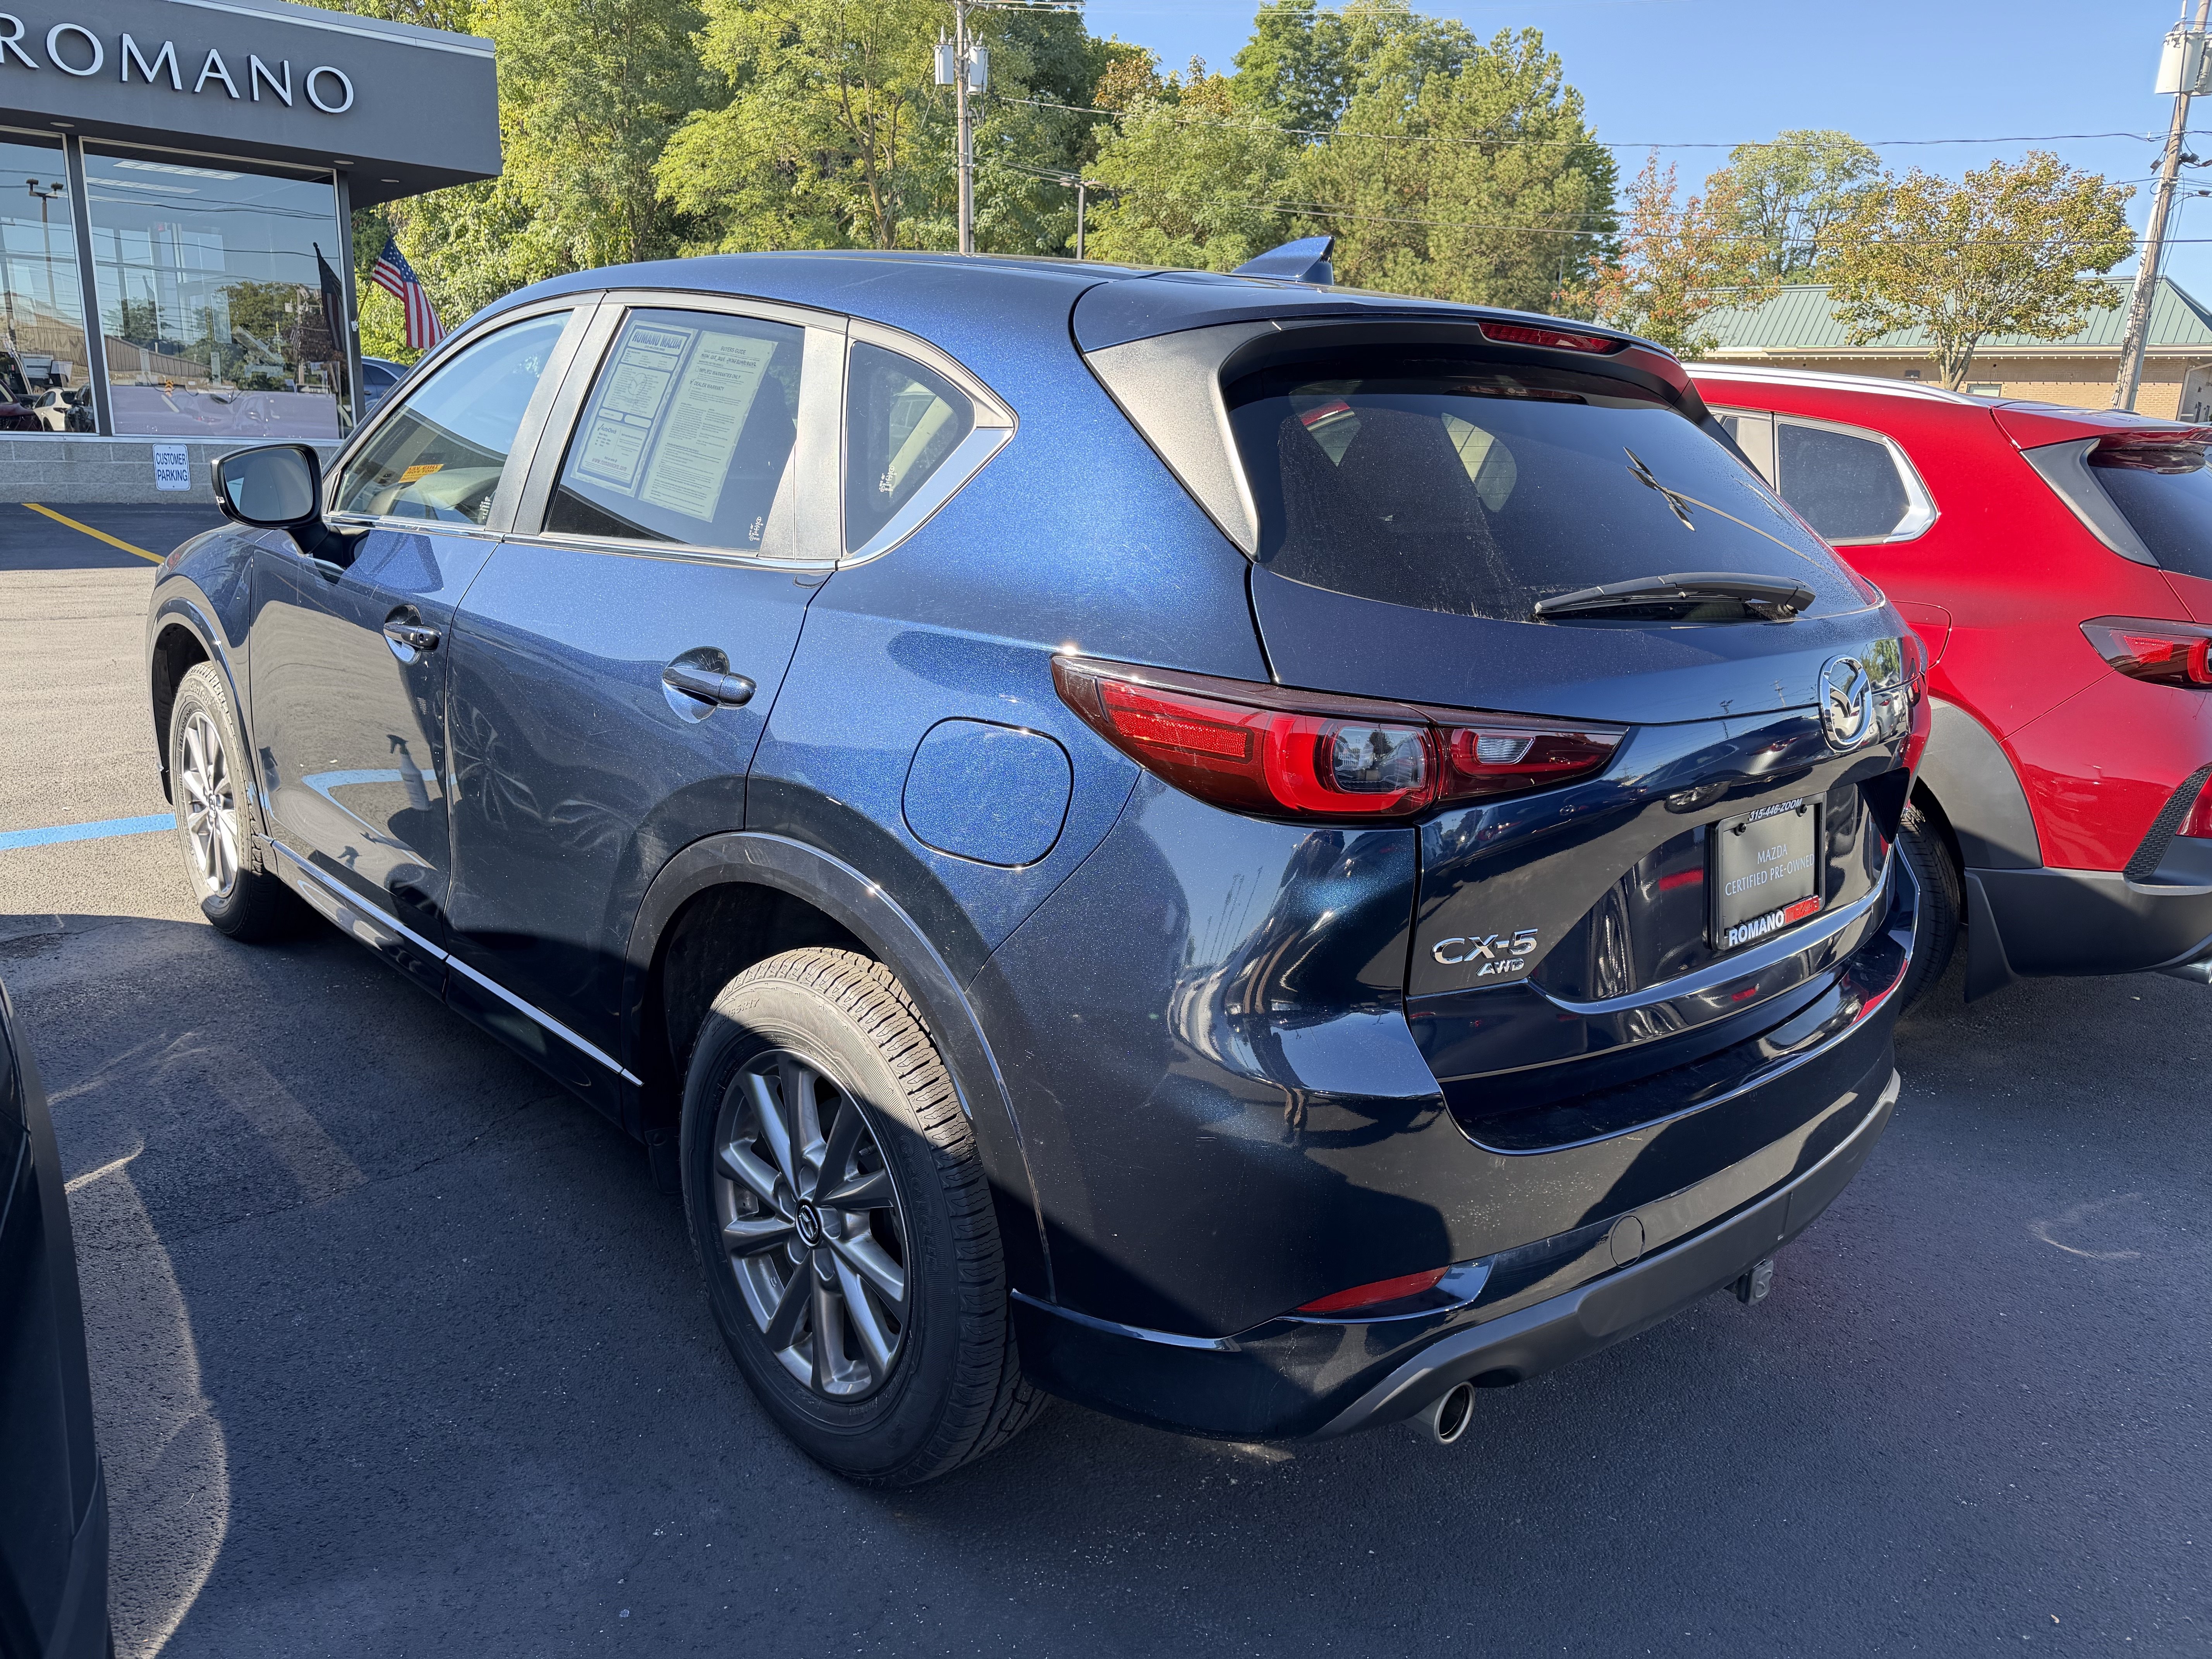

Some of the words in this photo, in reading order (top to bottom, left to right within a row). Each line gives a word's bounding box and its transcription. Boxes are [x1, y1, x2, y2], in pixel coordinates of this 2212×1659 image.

[0, 12, 354, 114] ROMANO
[632, 330, 661, 346] ROMANO
[660, 335, 683, 349] MAZDA
[156, 453, 186, 465] CUSTOMER
[157, 469, 188, 481] PARKING
[1757, 844, 1788, 864] MAZDA
[1725, 871, 1767, 896] CERTIFIED
[1770, 854, 1815, 880] PRE-OWNED
[1729, 910, 1784, 946] ROMANO
[1431, 929, 1538, 964] CX-5
[1476, 958, 1525, 976] AWD
